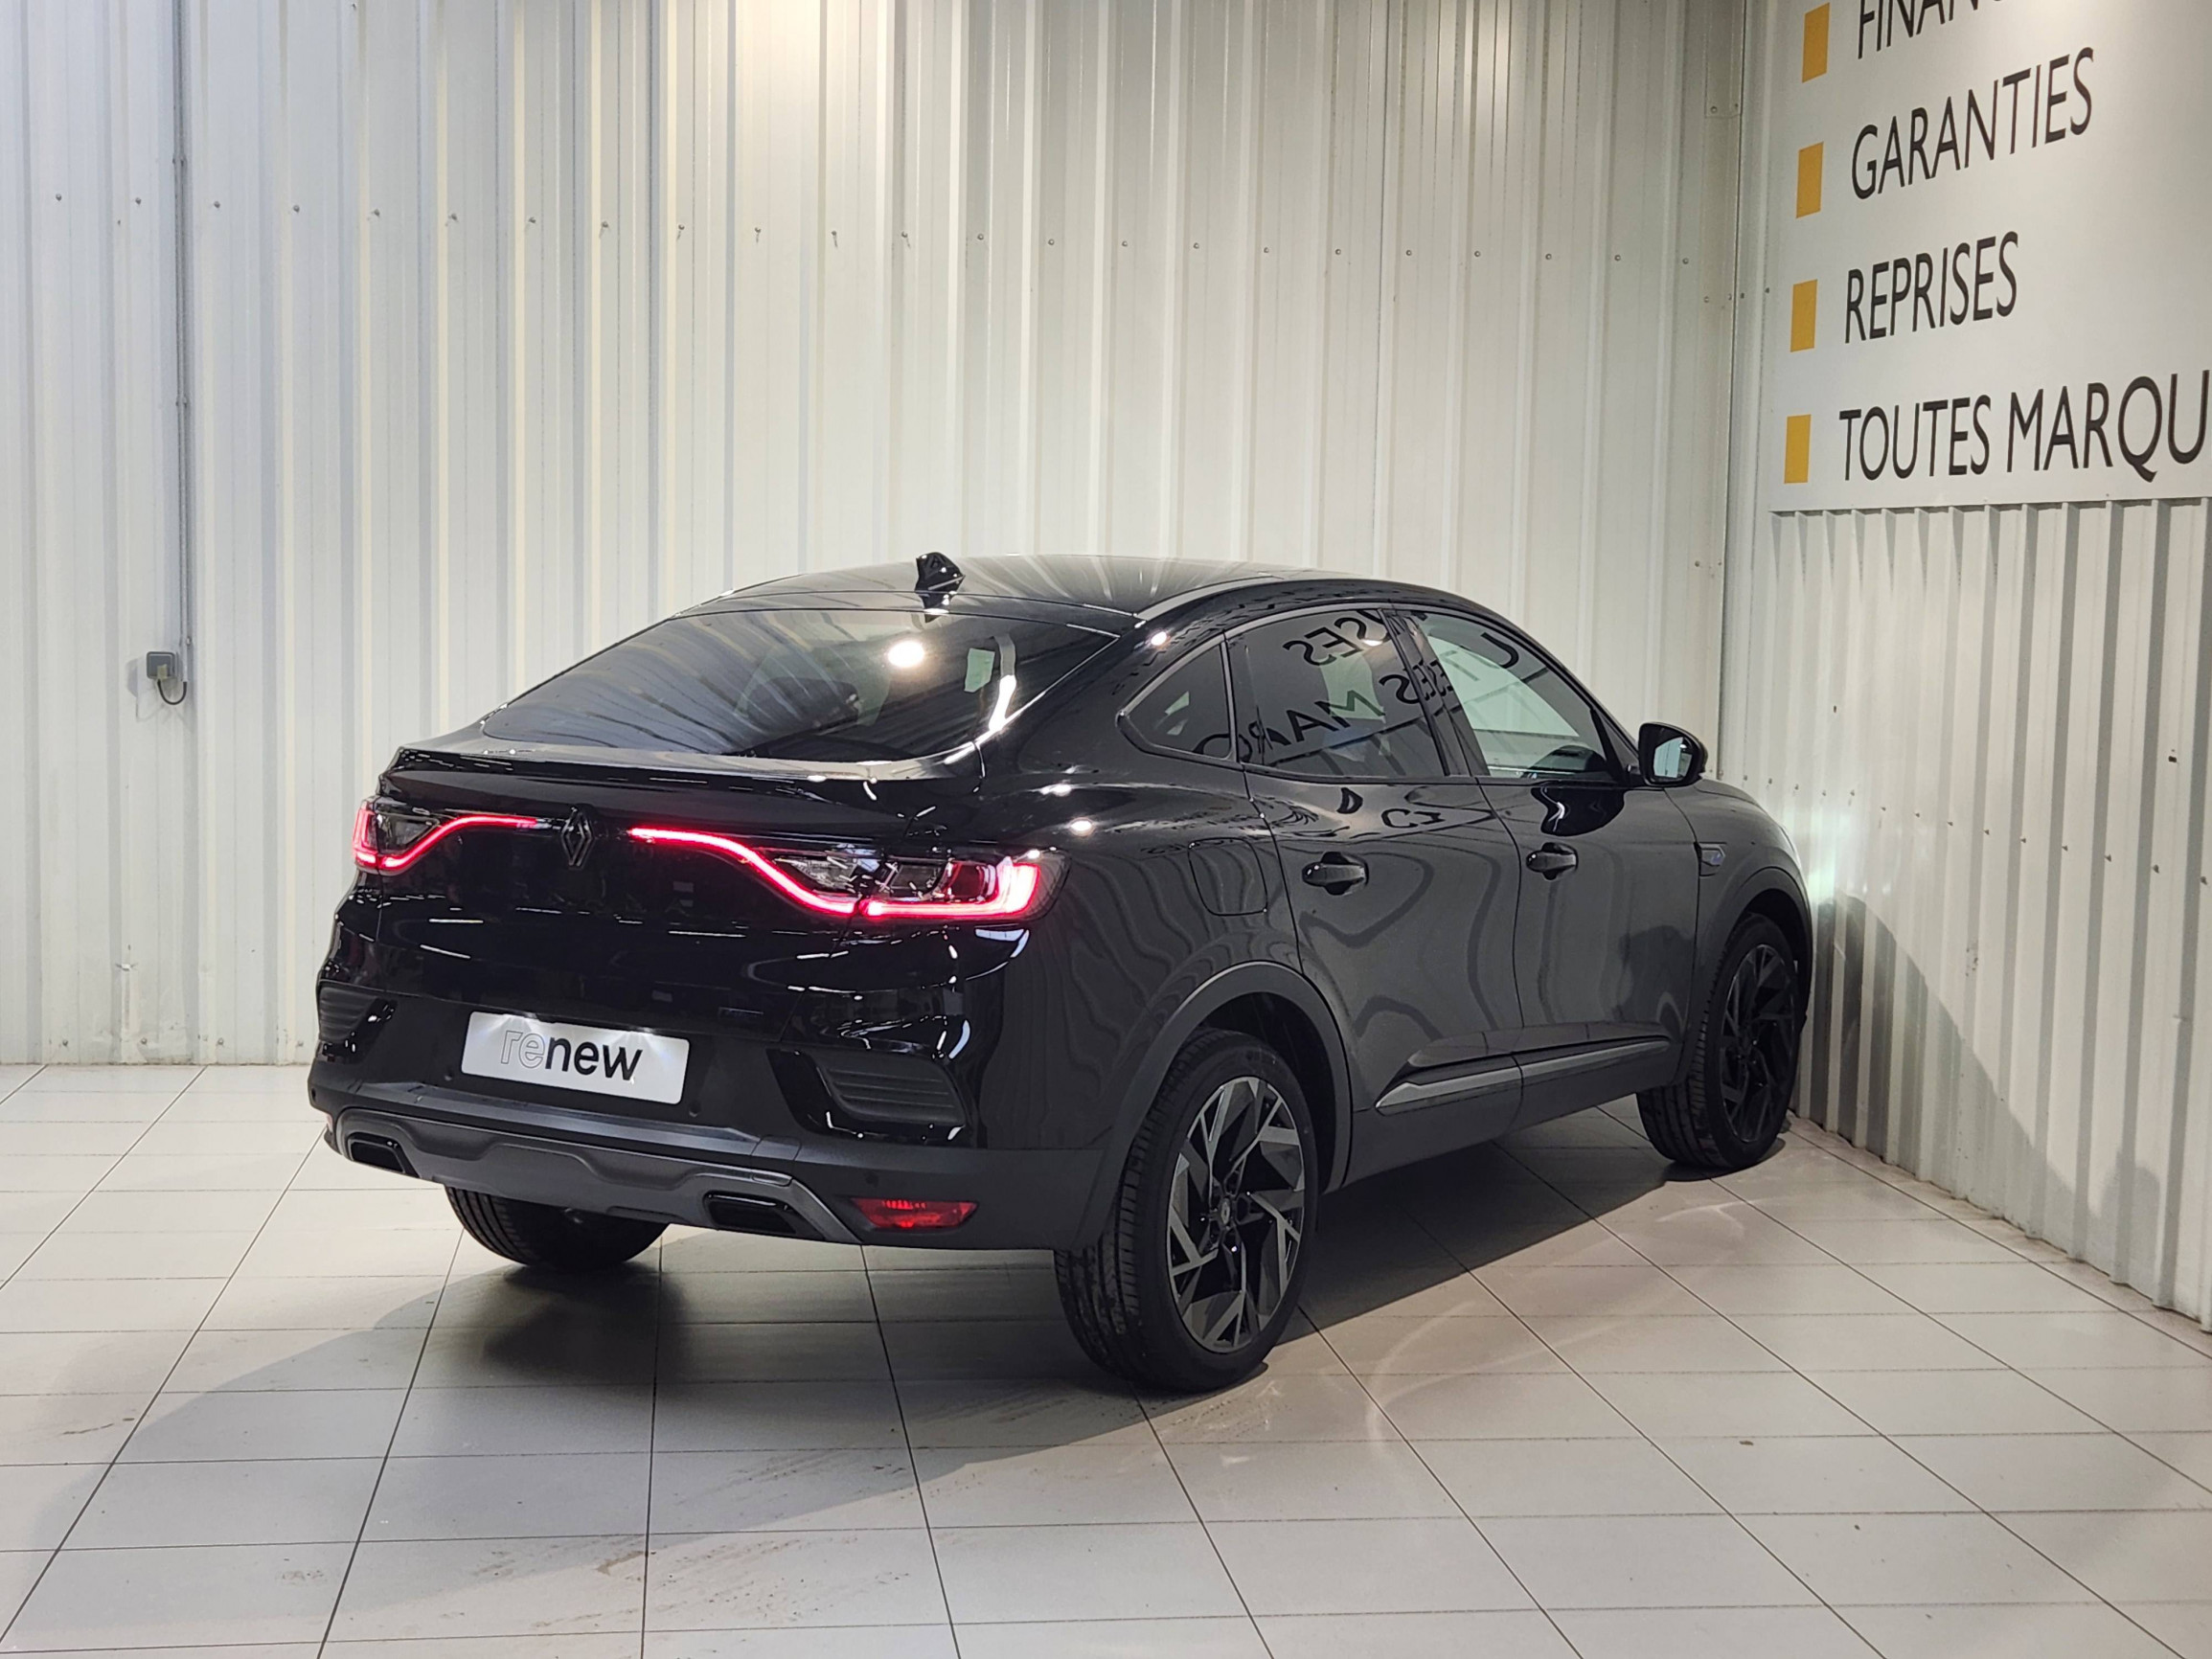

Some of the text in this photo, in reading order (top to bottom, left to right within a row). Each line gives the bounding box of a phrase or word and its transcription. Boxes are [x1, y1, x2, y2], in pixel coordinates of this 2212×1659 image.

[1858, 0, 2001, 59] FIN
[1850, 46, 2095, 200] GARANTIES
[1844, 230, 2019, 345] REPRISES
[1837, 369, 2211, 484] TOUTES MARQU
[499, 1030, 645, 1082] renew
